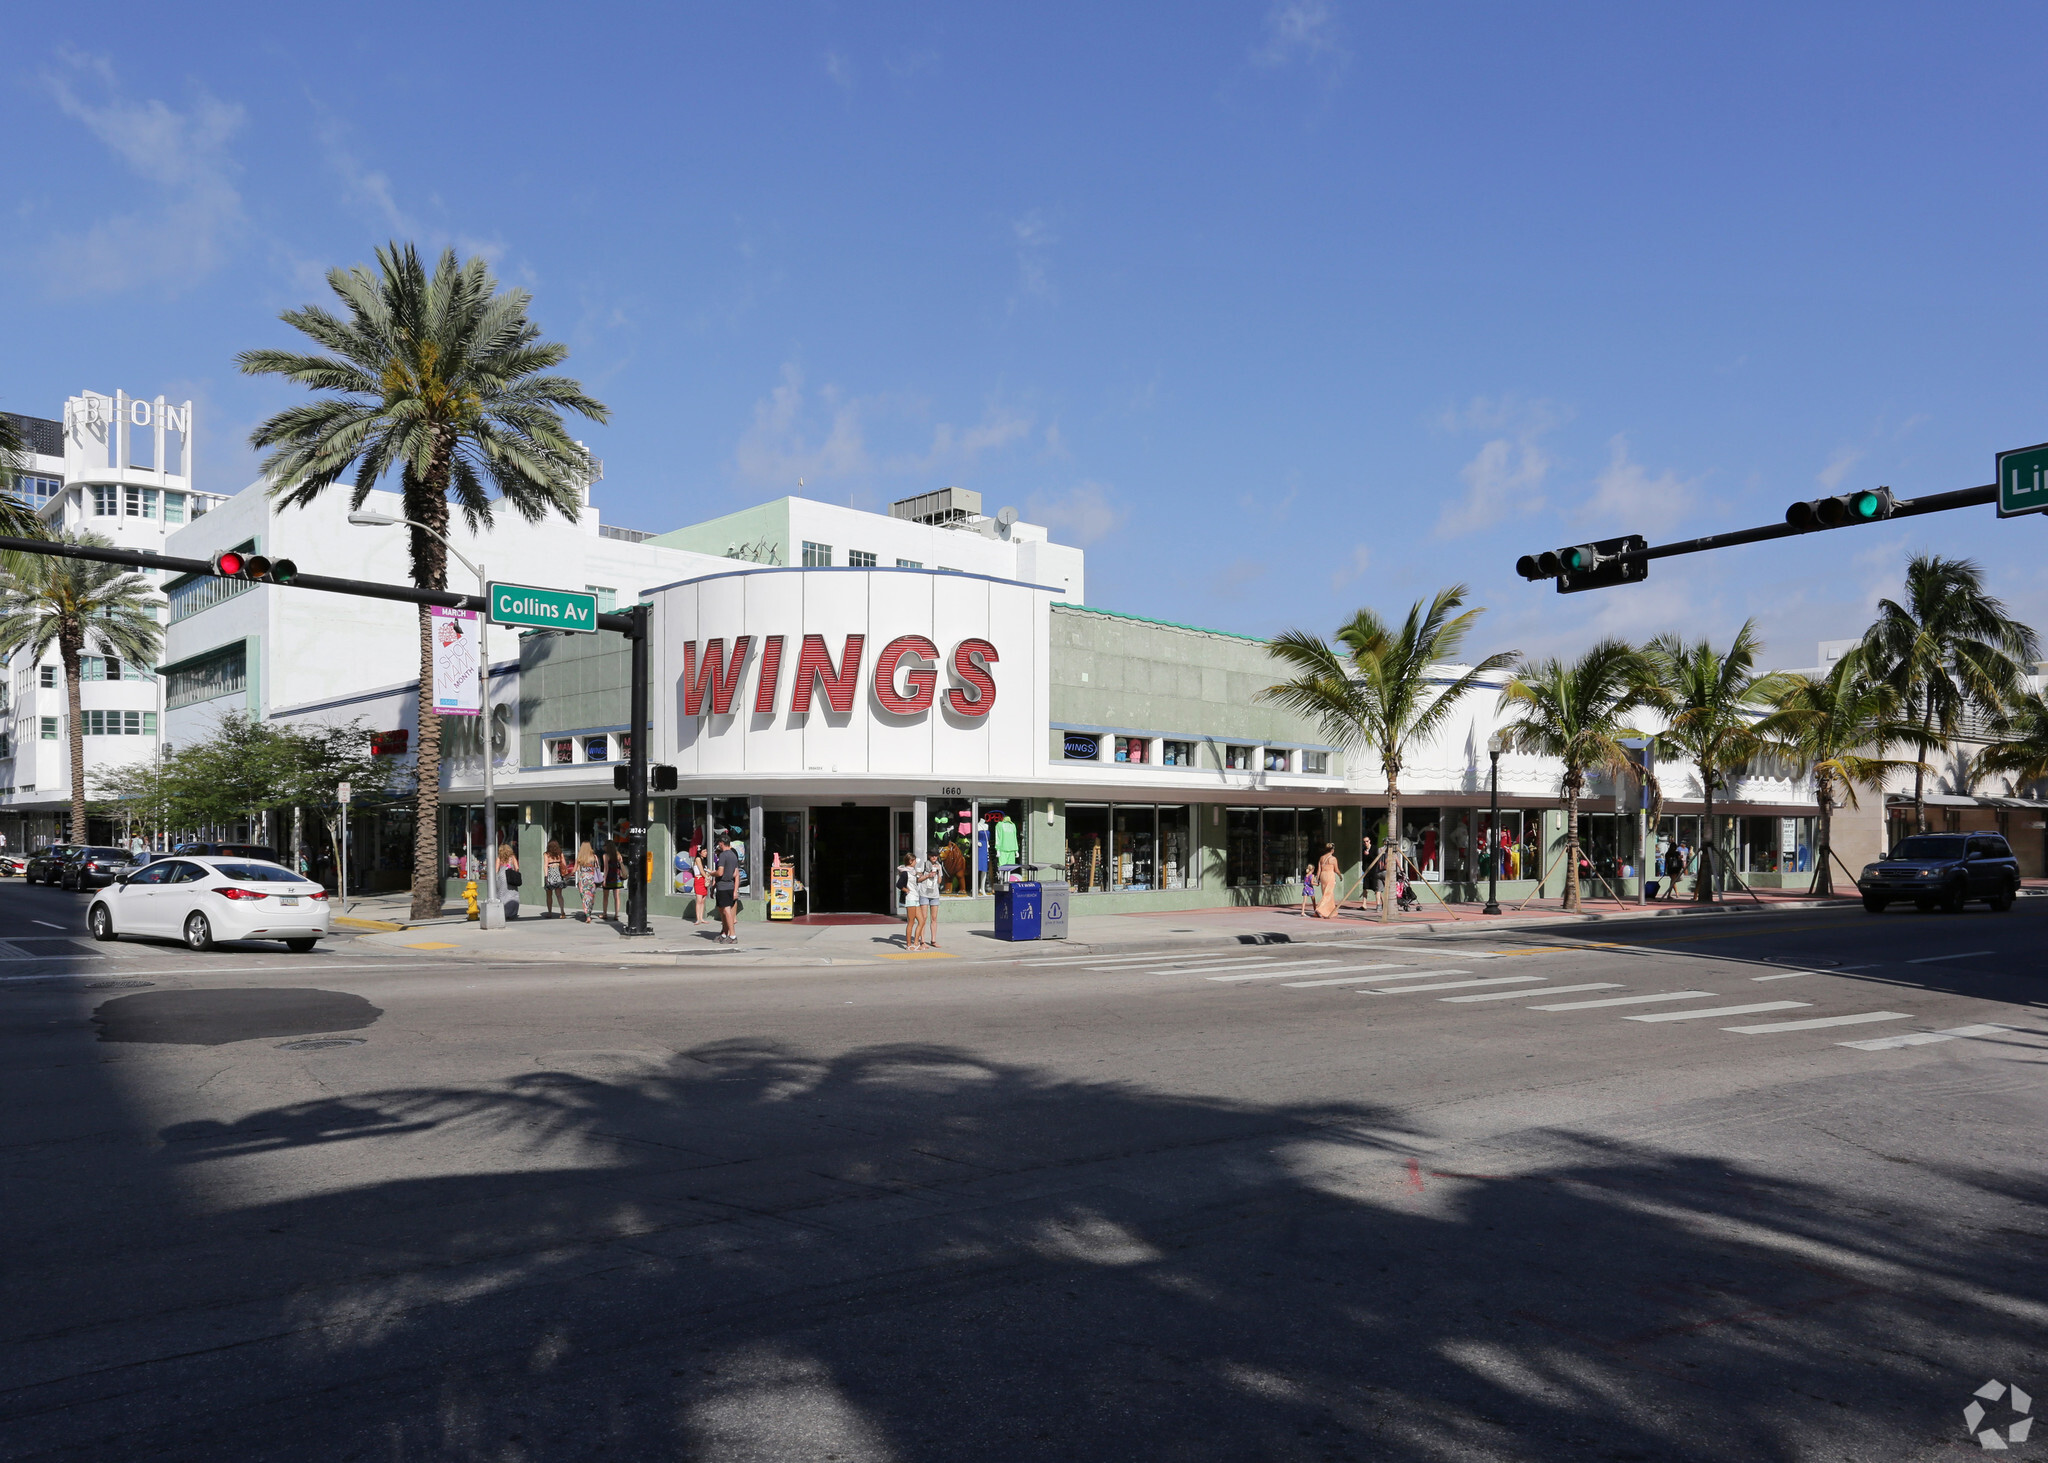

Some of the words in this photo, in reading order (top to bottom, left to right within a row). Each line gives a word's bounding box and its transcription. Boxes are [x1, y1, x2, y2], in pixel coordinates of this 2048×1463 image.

[442, 608, 466, 617] MARCH
[500, 595, 559, 618] Collins
[564, 602, 588, 621] Av
[439, 637, 468, 670] SHOP
[437, 651, 475, 695] MIAMI
[453, 666, 475, 689] MONTH
[684, 634, 999, 717] WINGS
[1064, 743, 1094, 753] WINGS
[942, 787, 962, 795] 1660
